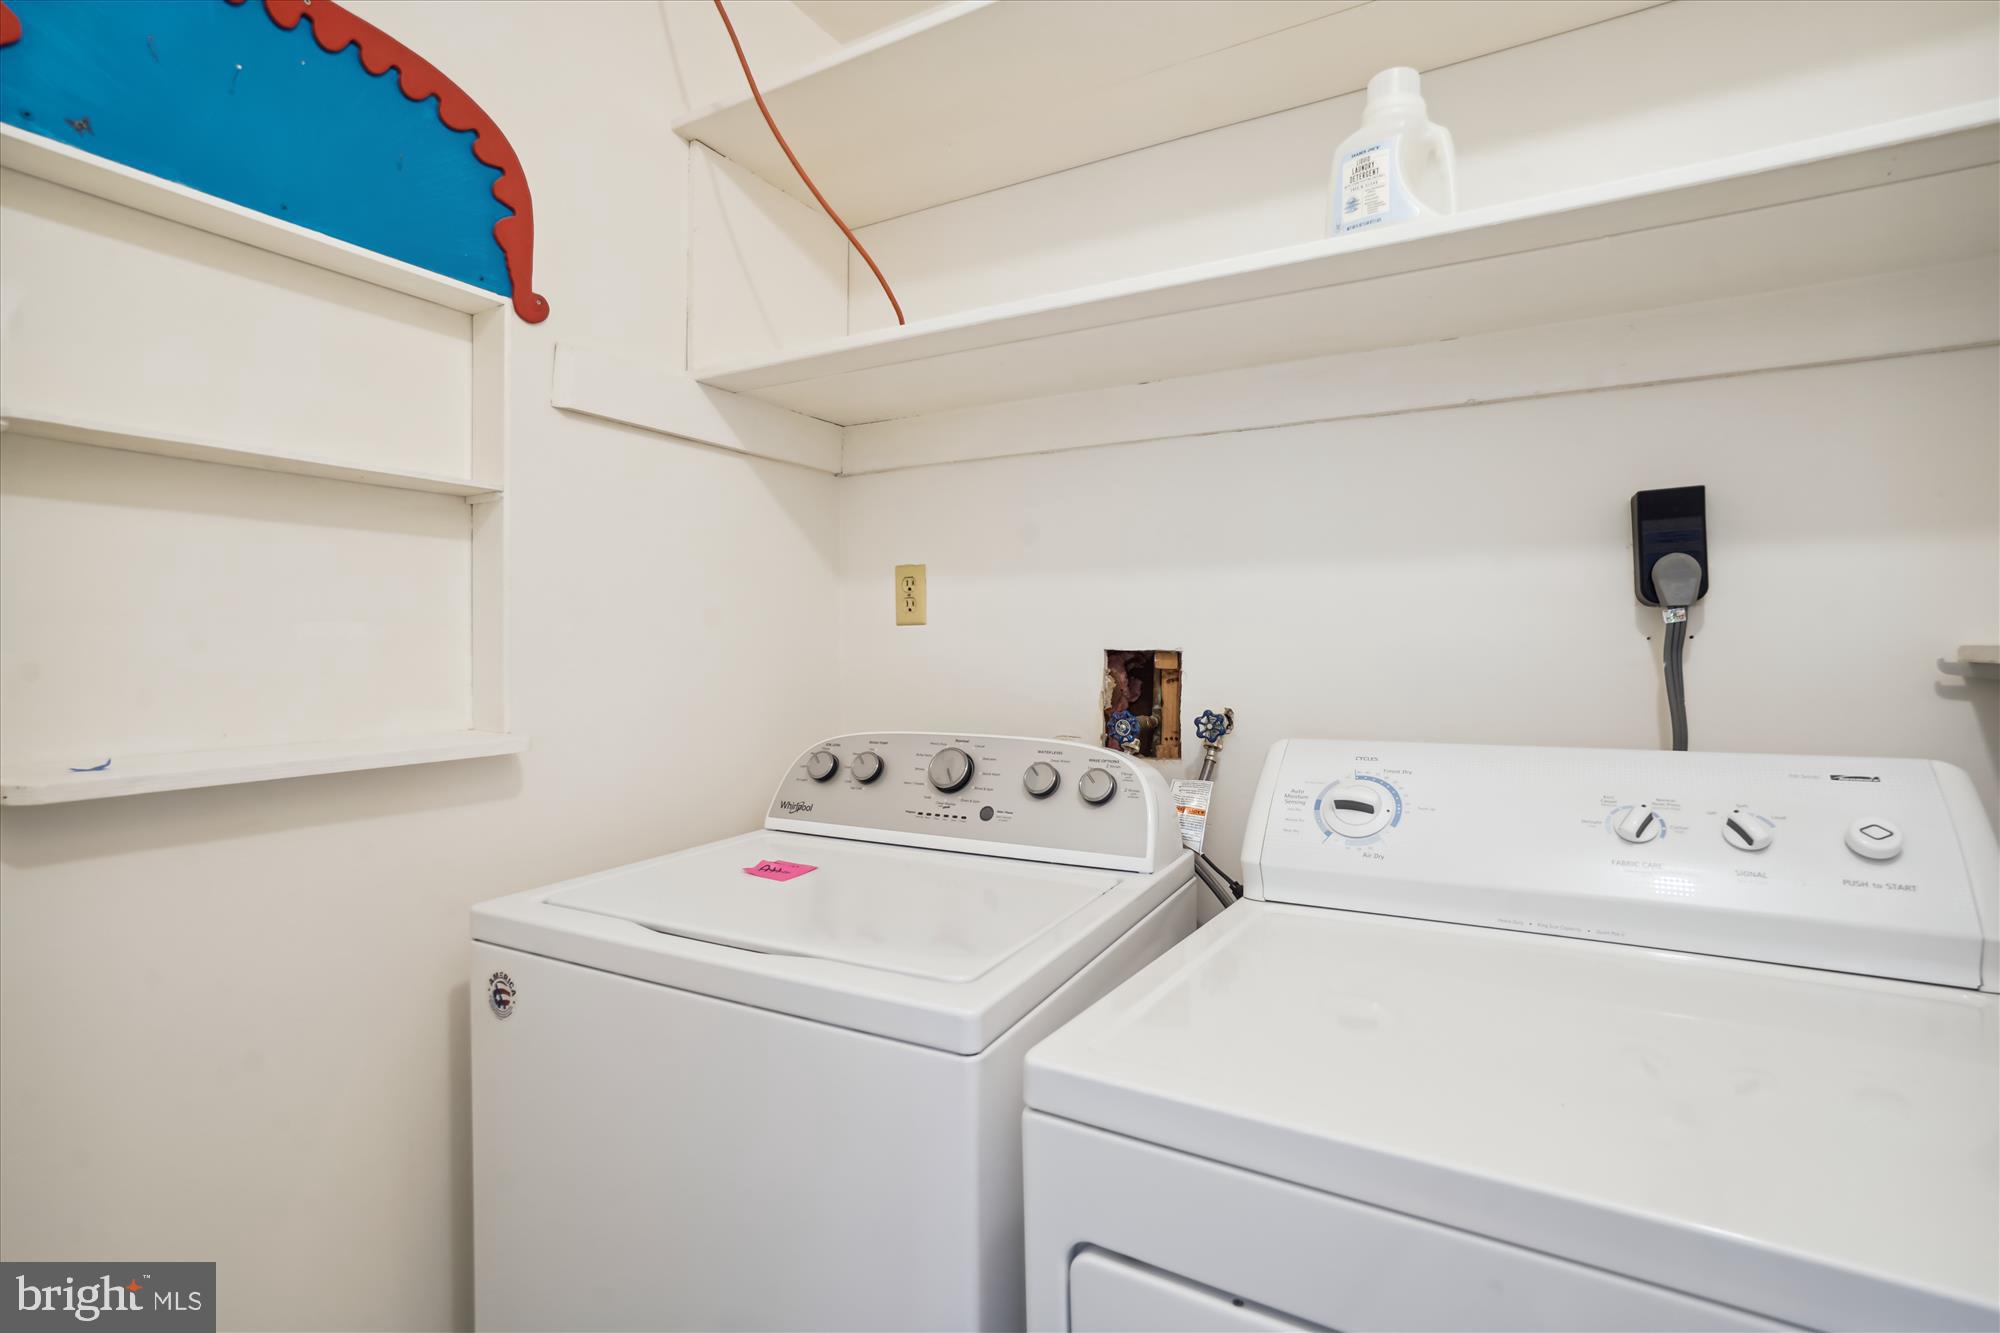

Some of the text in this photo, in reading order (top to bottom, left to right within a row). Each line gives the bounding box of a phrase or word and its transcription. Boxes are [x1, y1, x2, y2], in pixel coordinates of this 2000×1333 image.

[1351, 161, 1375, 175] LAUNDRY
[1349, 167, 1379, 184] DETERGENT
[780, 800, 814, 814] Whirlpool
[1373, 853, 1385, 861] Dry
[1611, 859, 1663, 870] FABRIC CARE
[1735, 870, 1768, 879] SIGNAL
[1842, 879, 1869, 888] PUSH
[1885, 883, 1917, 892] START
[489, 971, 517, 997] AMERICA
